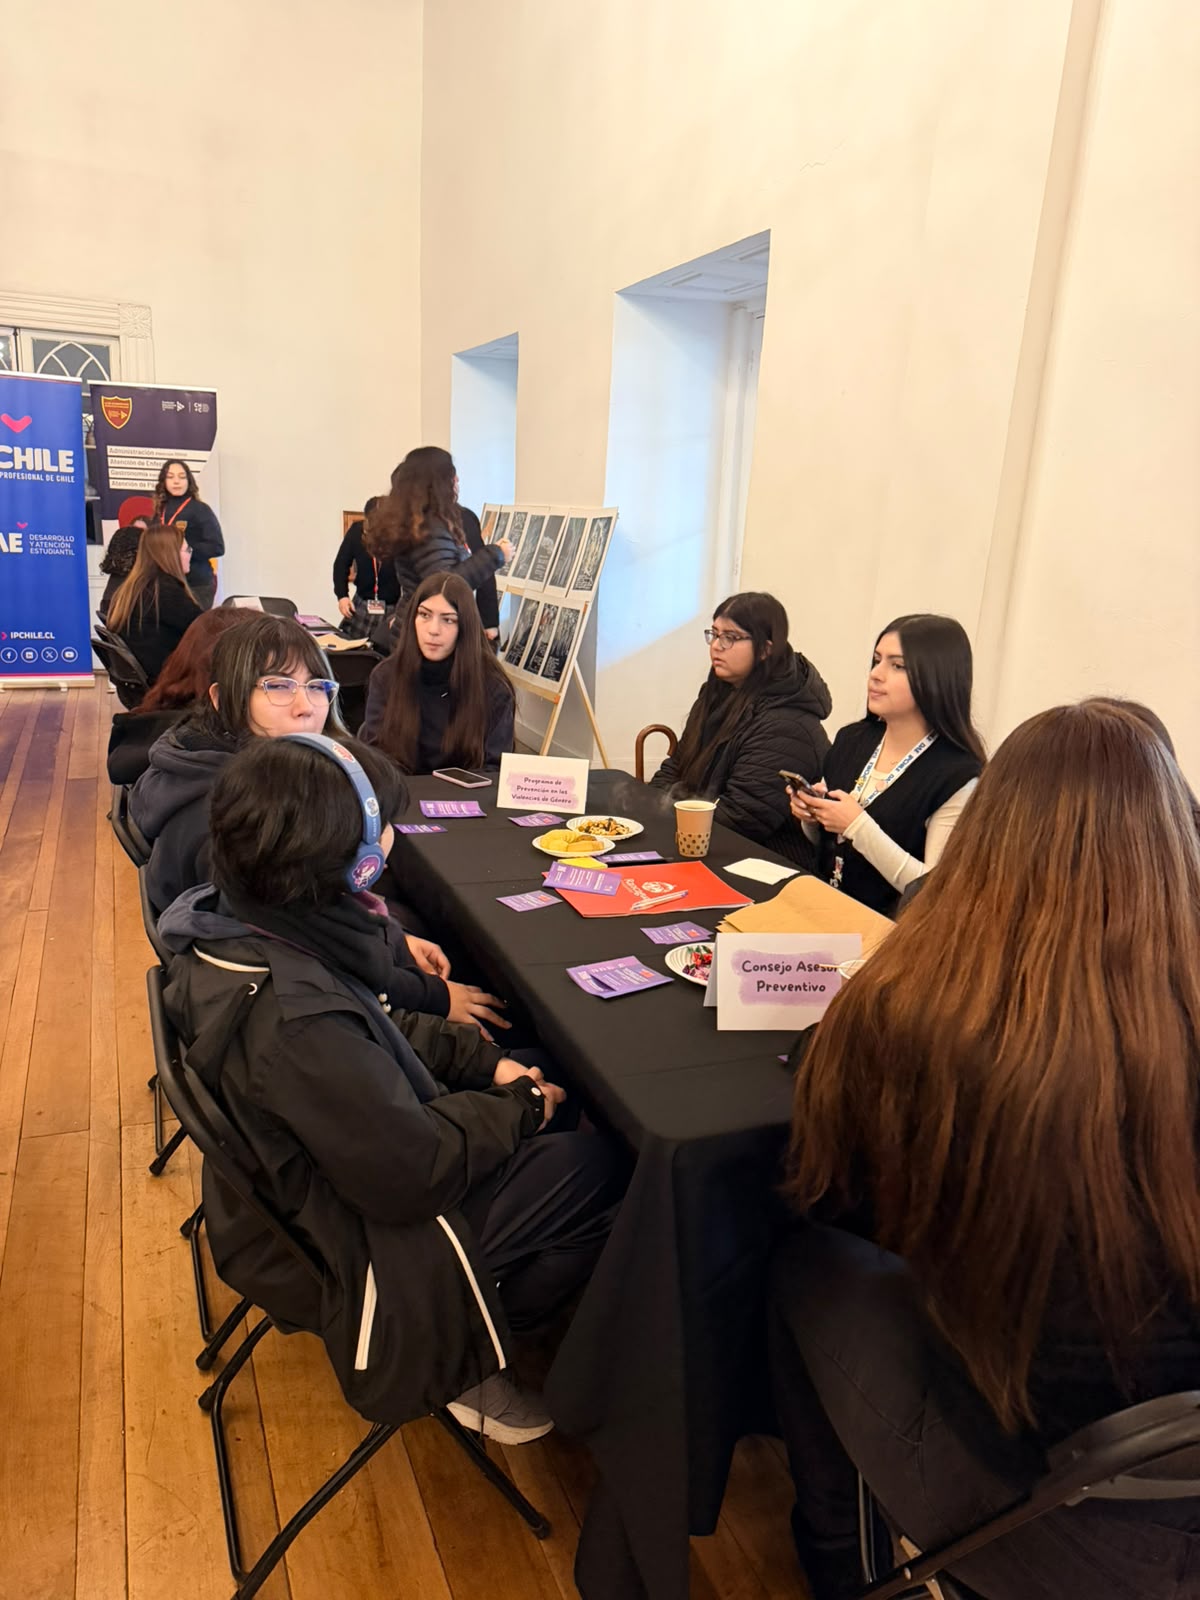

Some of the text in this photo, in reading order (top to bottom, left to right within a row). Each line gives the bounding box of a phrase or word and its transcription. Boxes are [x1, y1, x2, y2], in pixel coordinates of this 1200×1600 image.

[46, 474, 54, 482] DE
[56, 475, 75, 483] CHILE
[29, 533, 75, 543] DESARROLLO
[29, 541, 71, 549] Y ATENCIÓN
[30, 548, 75, 556] ESTUDIANTIL
[11, 632, 55, 640] IPCHILE.CL
[524, 777, 553, 785] Programa
[516, 785, 549, 793] Prevención
[742, 960, 792, 975] Consejo
[757, 980, 826, 992] Preventivo
